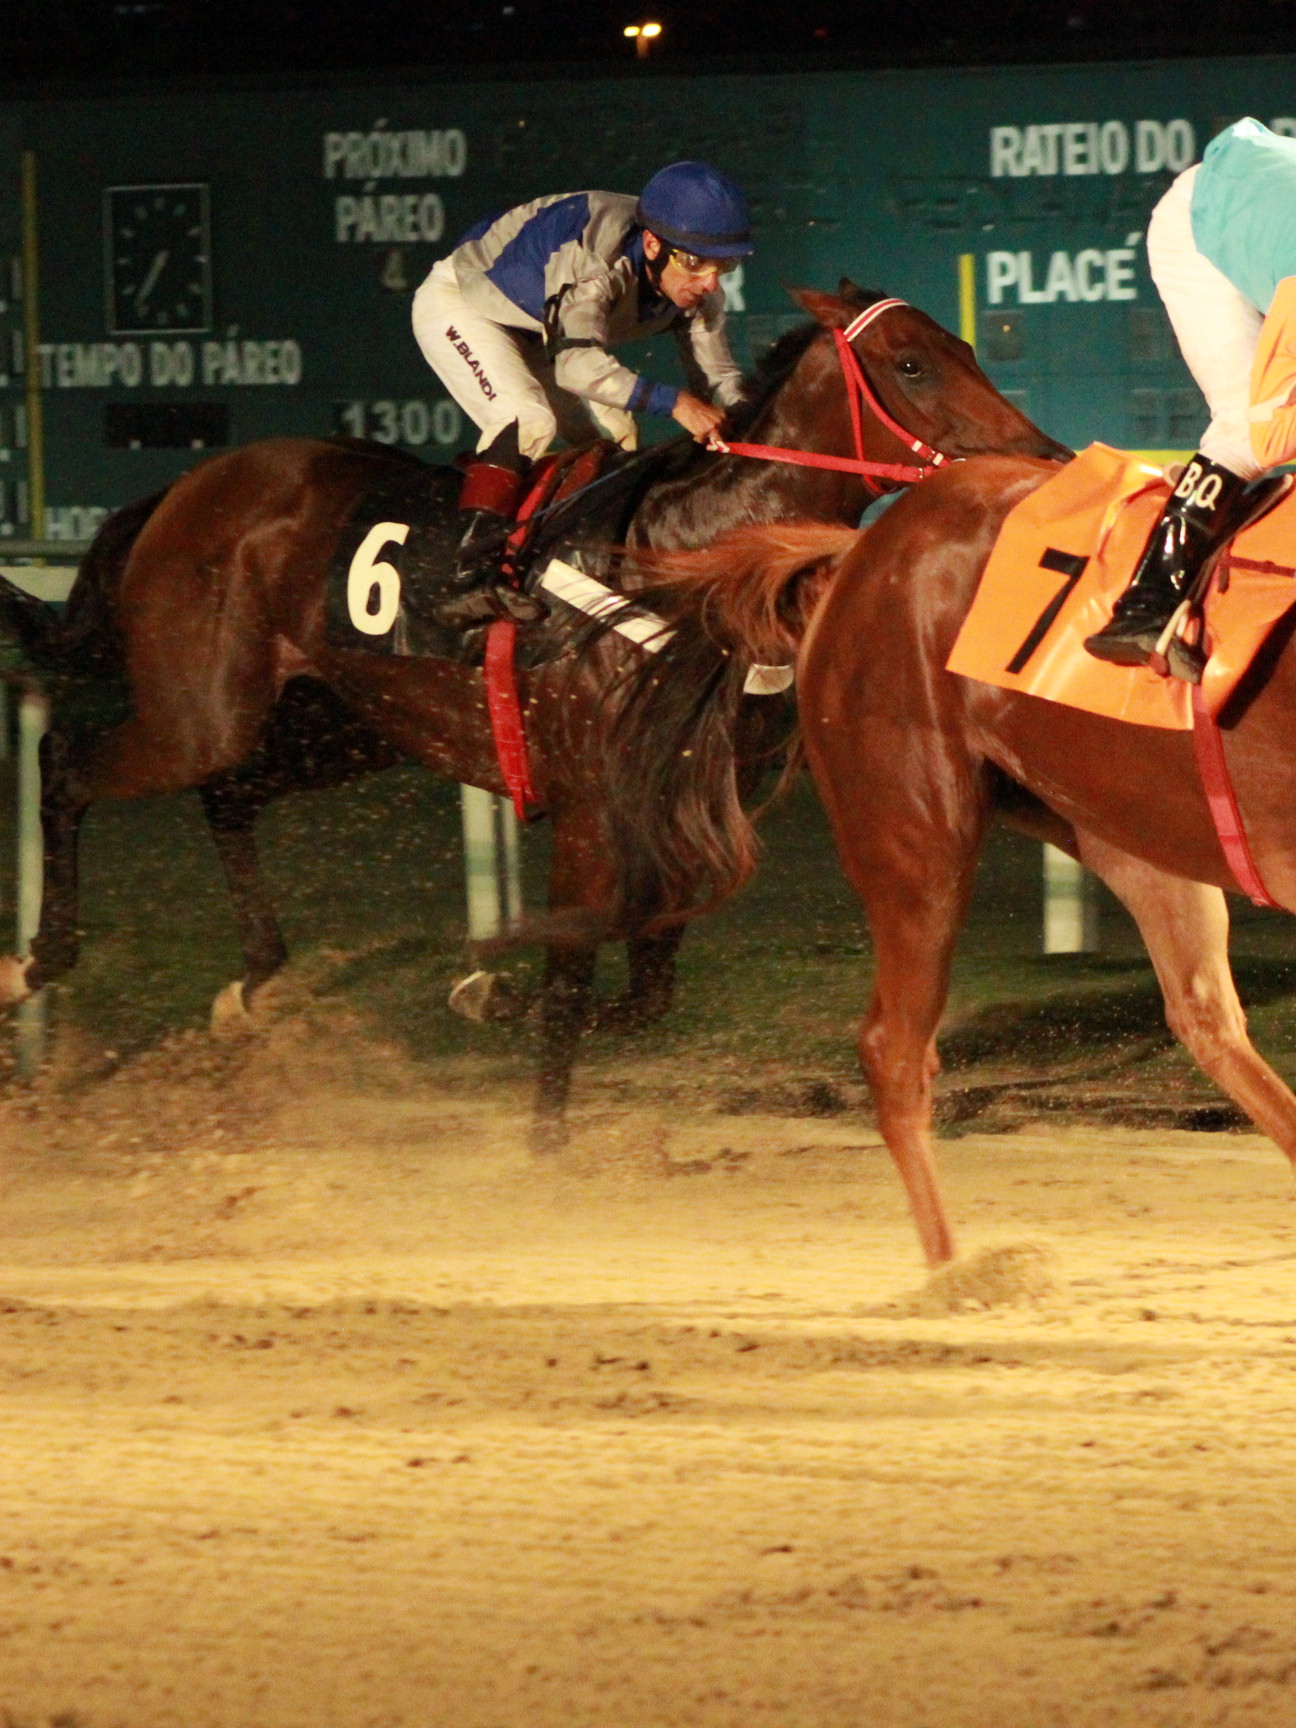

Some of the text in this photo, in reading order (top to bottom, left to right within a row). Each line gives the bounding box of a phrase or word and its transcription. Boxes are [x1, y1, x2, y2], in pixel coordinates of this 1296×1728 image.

[323, 117, 467, 178] PRÓXIMO
[990, 119, 1128, 177] RATEIO
[1133, 118, 1195, 173] DO
[333, 180, 445, 242] PÁREO
[37, 340, 143, 388] TEMPO
[150, 340, 195, 387] DO
[202, 324, 300, 384] PÁREO
[340, 400, 462, 445] 1300
[347, 521, 410, 636] 6
[1005, 547, 1089, 674] 7
